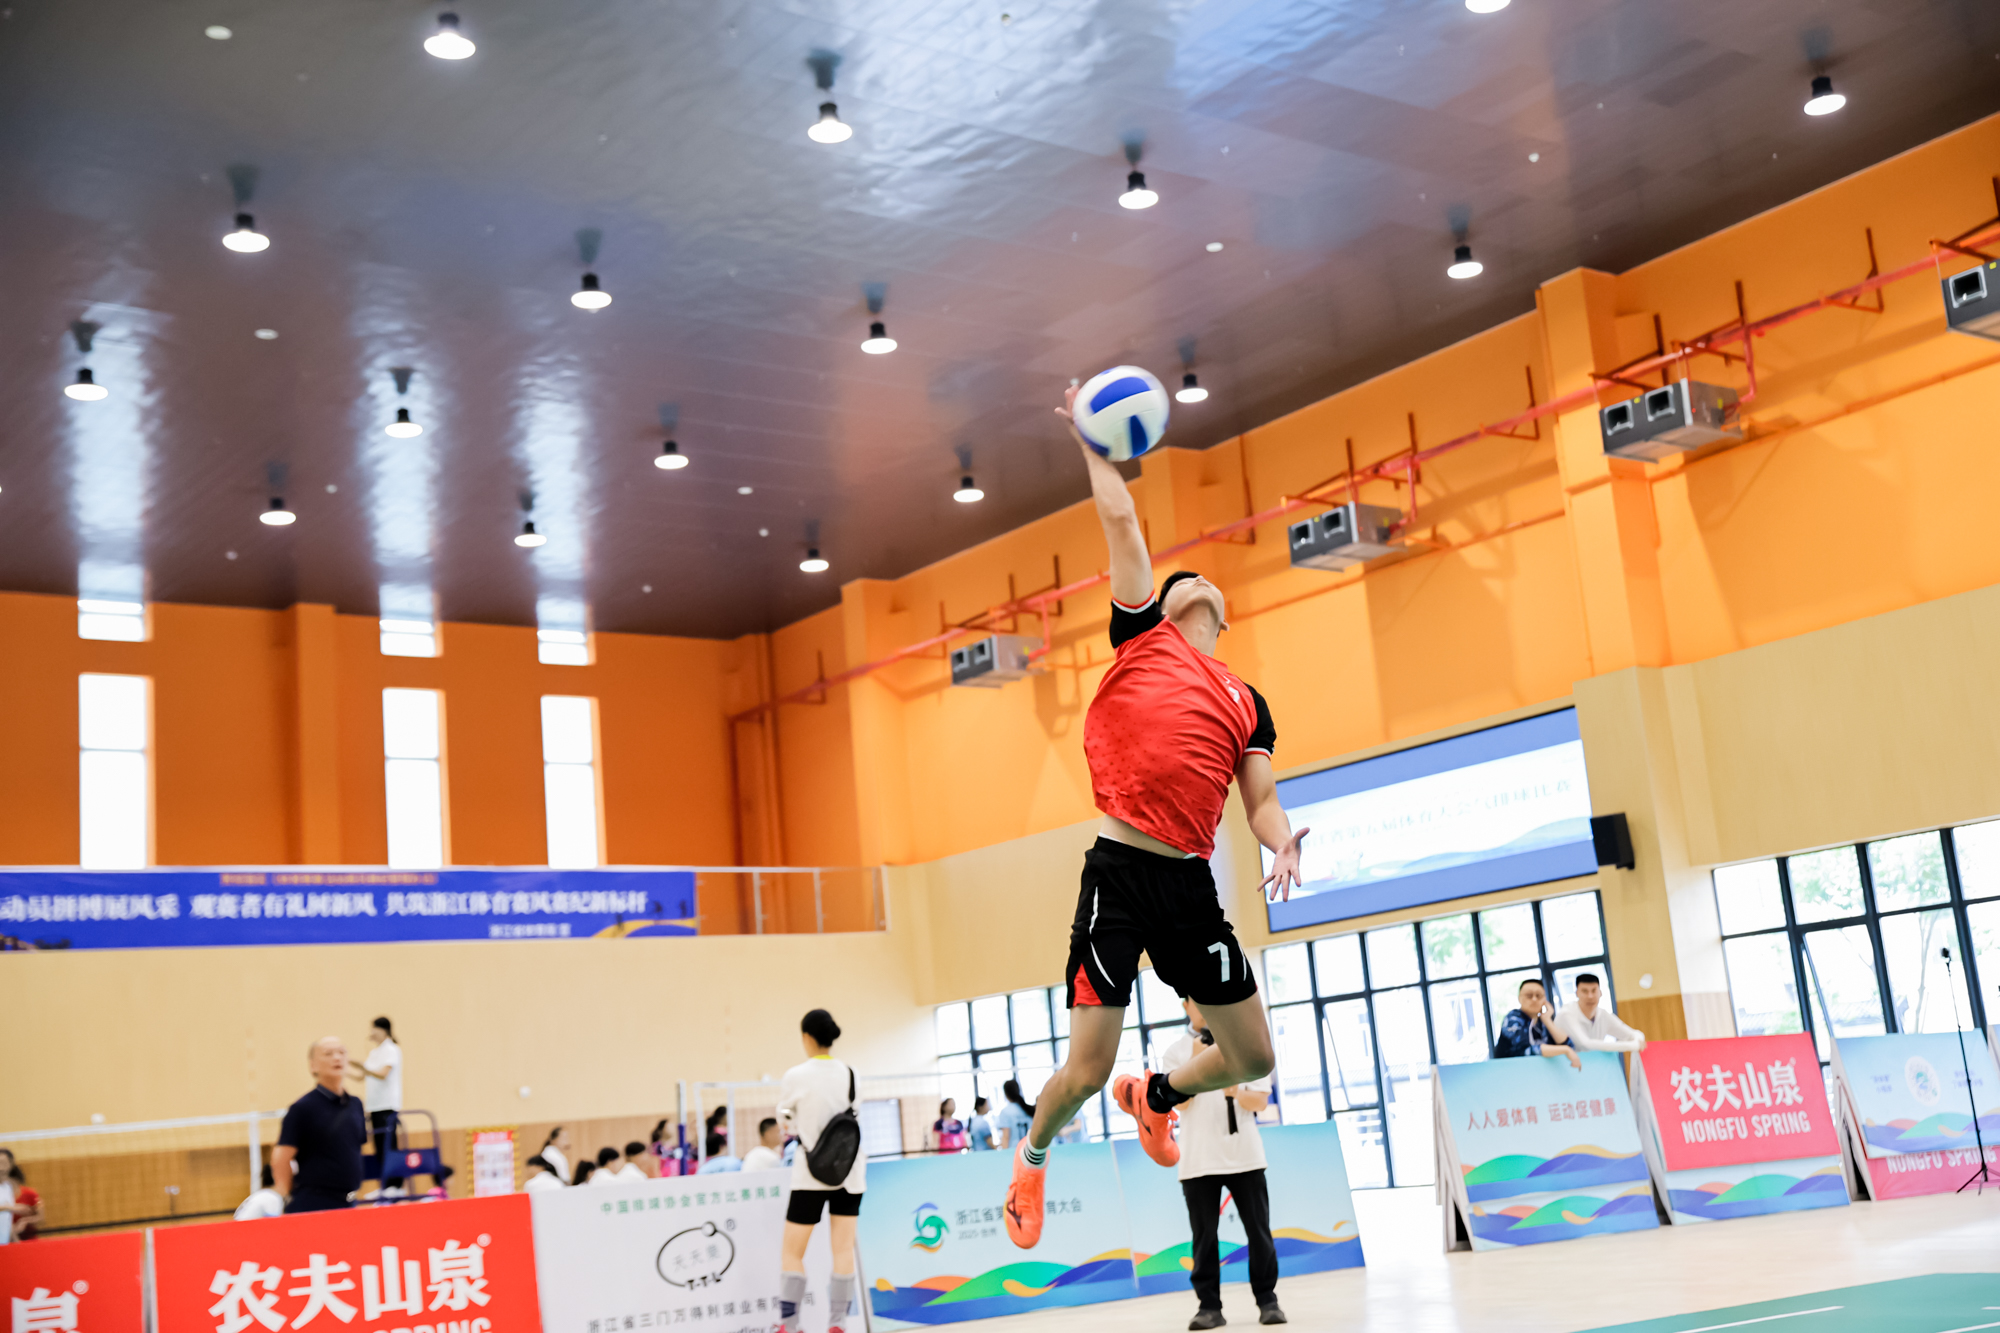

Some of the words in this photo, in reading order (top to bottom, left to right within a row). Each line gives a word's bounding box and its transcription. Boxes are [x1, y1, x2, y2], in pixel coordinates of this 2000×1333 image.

[1670, 1060, 1804, 1115] 农夫山泉
[1467, 1106, 1539, 1131] 人人爱体育
[1548, 1097, 1617, 1123] 运动促健康
[1681, 1116, 1749, 1144] NONGFU
[1751, 1110, 1812, 1138] SPRING
[956, 1198, 1082, 1226] 浙江省第育大会
[208, 1239, 492, 1333] 农夫山泉
[587, 1291, 815, 1332] 浙江省三门万得利球业有限司
